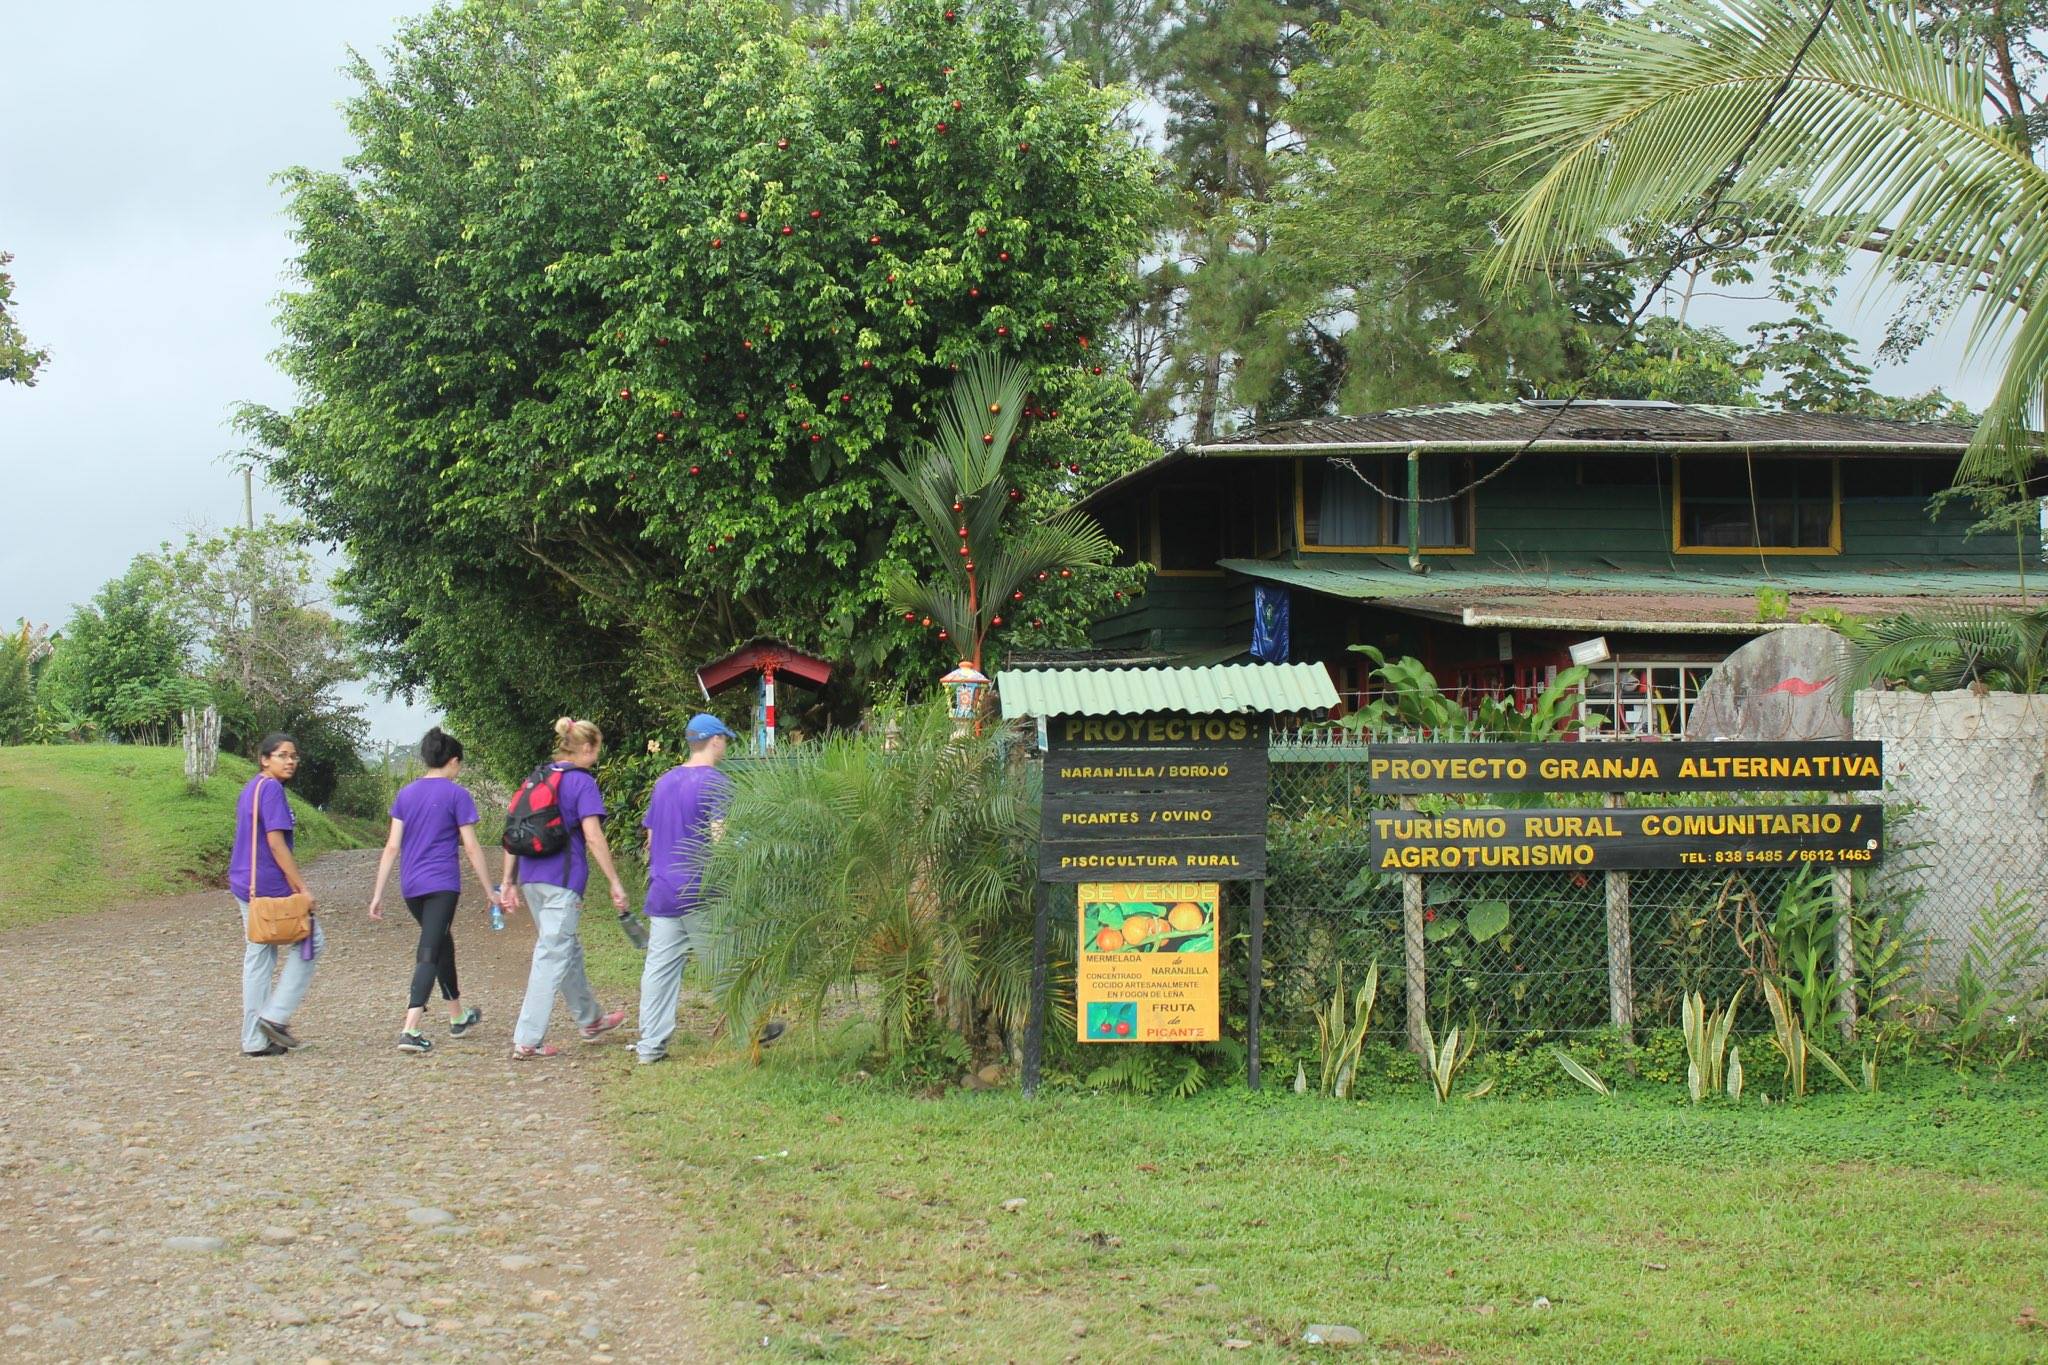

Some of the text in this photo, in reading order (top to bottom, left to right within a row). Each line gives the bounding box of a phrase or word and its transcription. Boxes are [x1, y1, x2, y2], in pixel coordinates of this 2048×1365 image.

[1061, 762, 1229, 778] NARANJILLA / BOROJÓ
[1371, 756, 1880, 779] PROYECTO GRANJA ALTERNATIVA
[1062, 812, 1139, 824] PICANTES
[1375, 814, 1862, 840] TURISMO RURAL COMUNITARIO /
[1061, 855, 1240, 868] PISCICULTURA RURAL
[1381, 845, 1595, 868] AGROTURISMO
[1680, 853, 1712, 863] TEL:
[1715, 850, 1742, 862] 838
[1746, 850, 1783, 862] 5485
[1800, 849, 1834, 861] 6612
[1838, 849, 1872, 860] 1463
[1080, 883, 1217, 900] SE VENDE
[1086, 955, 1142, 963] MERMELADA
[1151, 967, 1209, 975] NARANJILLA
[1125, 981, 1200, 989] ARTESANALMENTE
[1152, 1003, 1196, 1012] FRUTA
[1146, 1027, 1205, 1038] PICANTE
